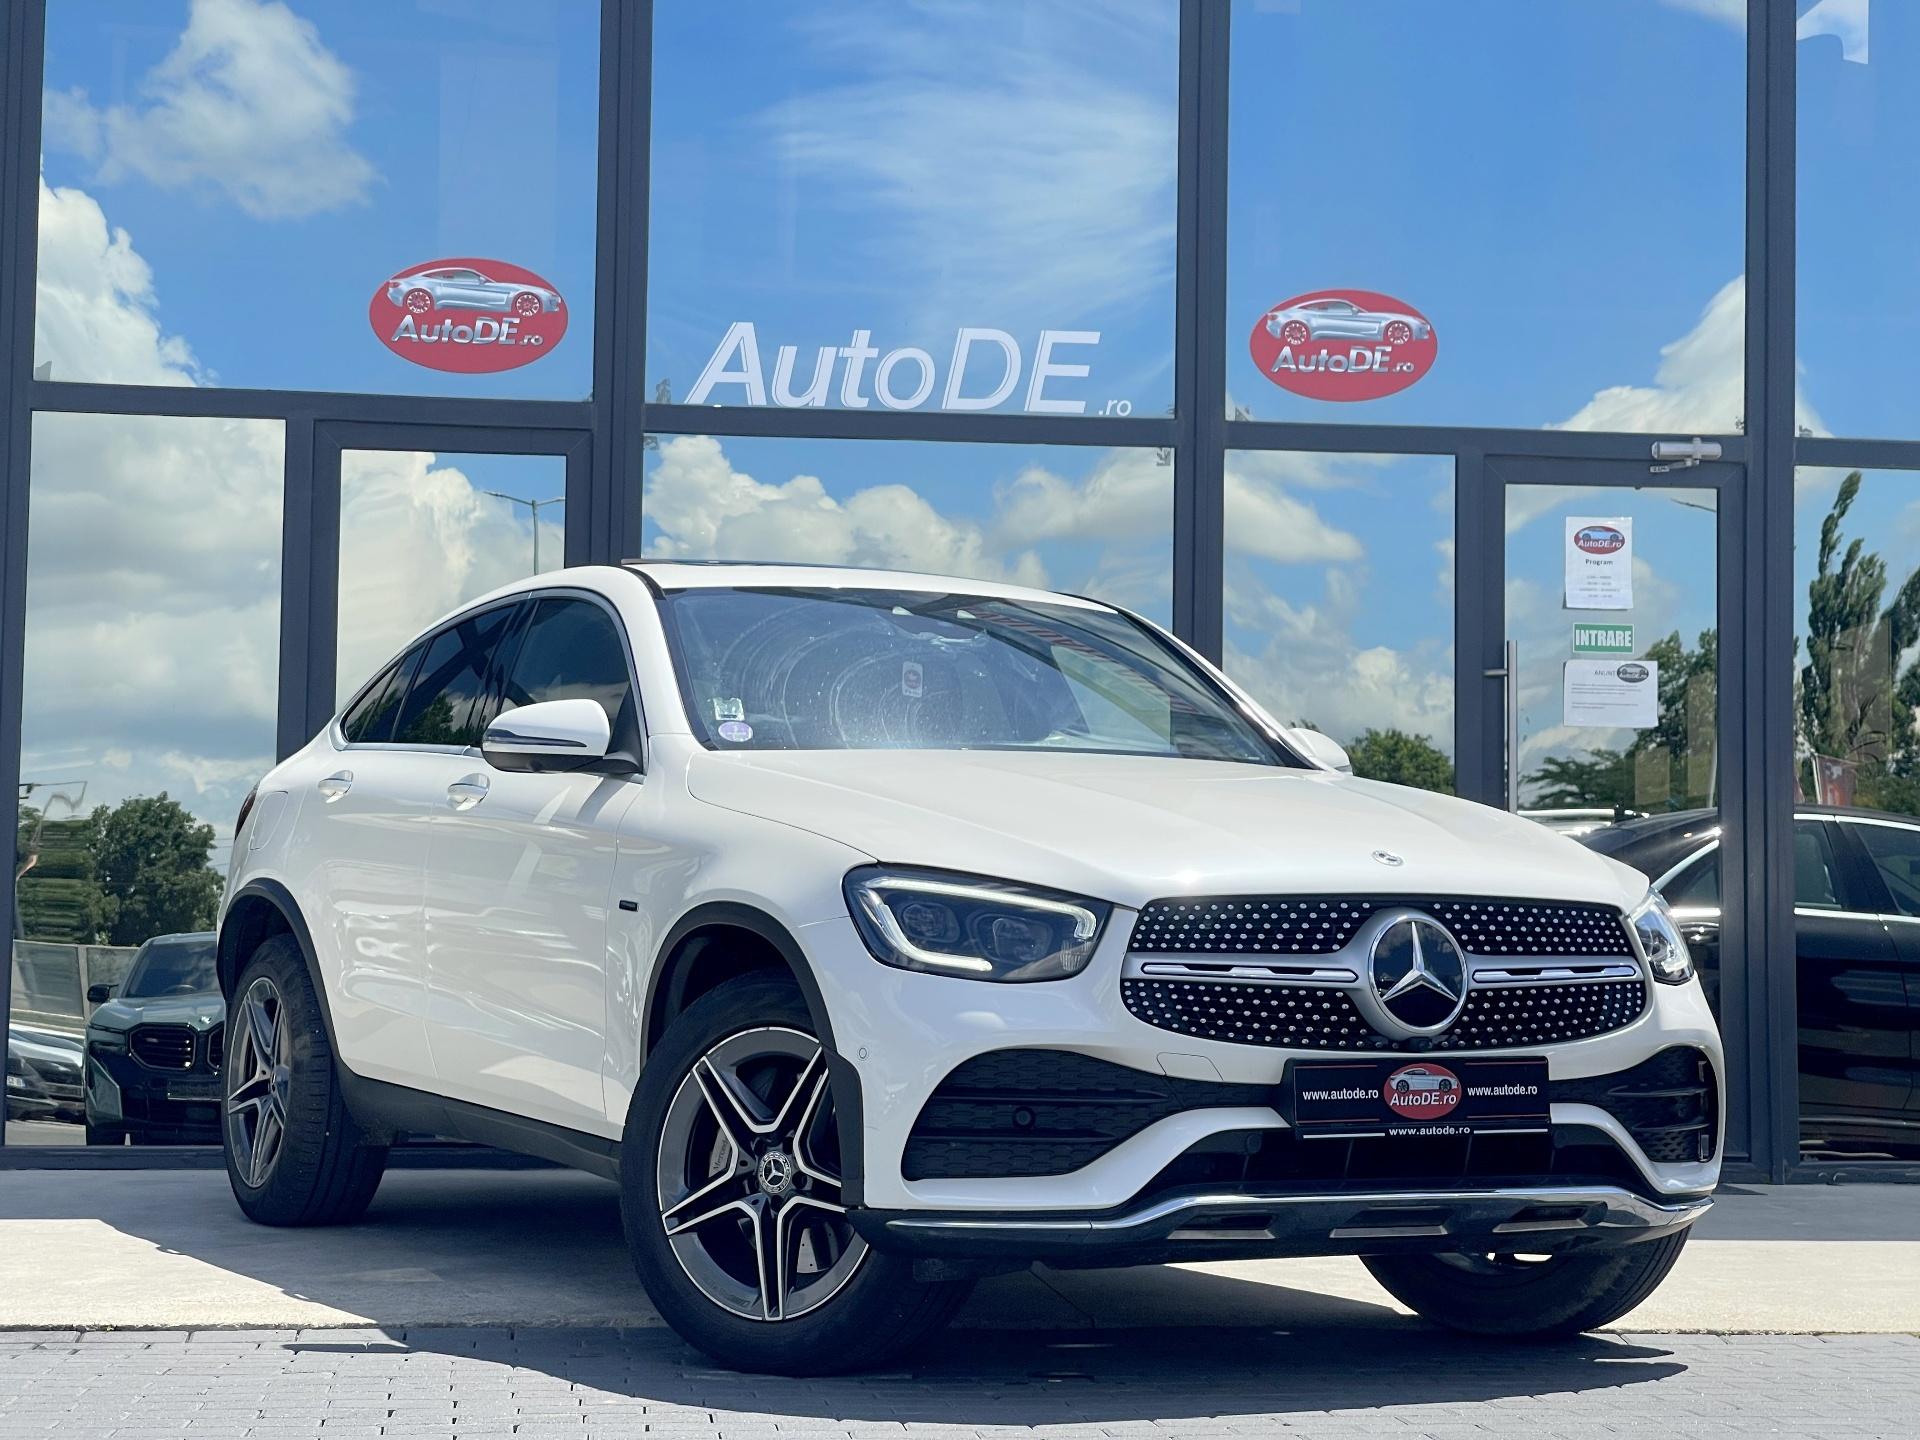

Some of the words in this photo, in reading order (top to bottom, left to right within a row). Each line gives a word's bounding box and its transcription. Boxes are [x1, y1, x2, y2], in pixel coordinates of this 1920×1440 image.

[1578, 539, 1622, 549] AutoDE.ro
[1585, 558, 1613, 566] Program
[1575, 629, 1632, 647] INTRARE
[1303, 1088, 1379, 1100] www.autode.ro
[1467, 1083, 1538, 1097] www.autode.ro
[1390, 1092, 1457, 1106] AutoDE.ro
[1389, 1125, 1471, 1136] www.autode.ro
